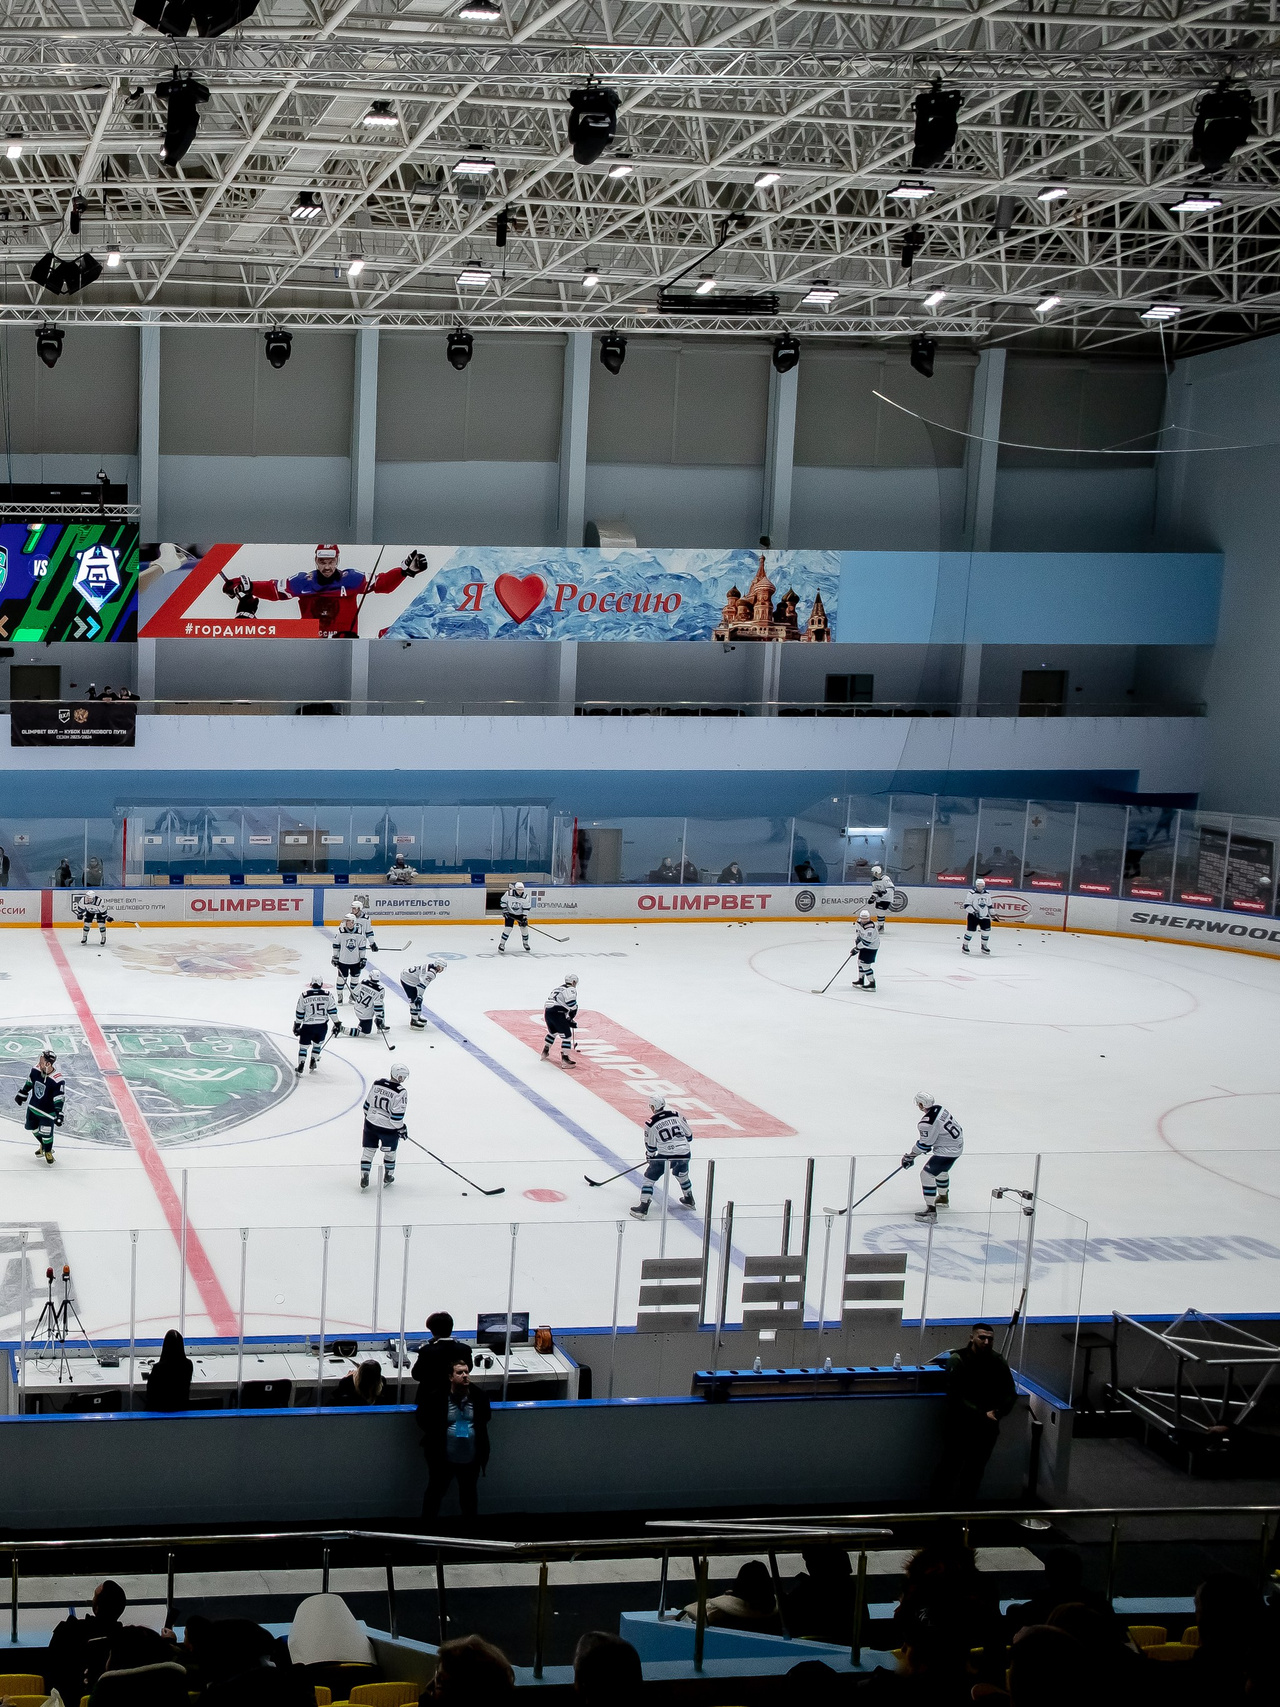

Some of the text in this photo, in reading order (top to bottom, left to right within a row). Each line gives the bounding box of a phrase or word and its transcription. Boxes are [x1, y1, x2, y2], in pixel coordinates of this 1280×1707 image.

[34, 560, 48, 576] VS
[456, 582, 682, 614] Я Россию
[184, 622, 276, 637] #гордимся
[190, 898, 304, 912] OLIMPBET
[637, 894, 772, 911] OLIMPBET
[994, 903, 1028, 912] INTEC
[310, 1002, 326, 1016] 15
